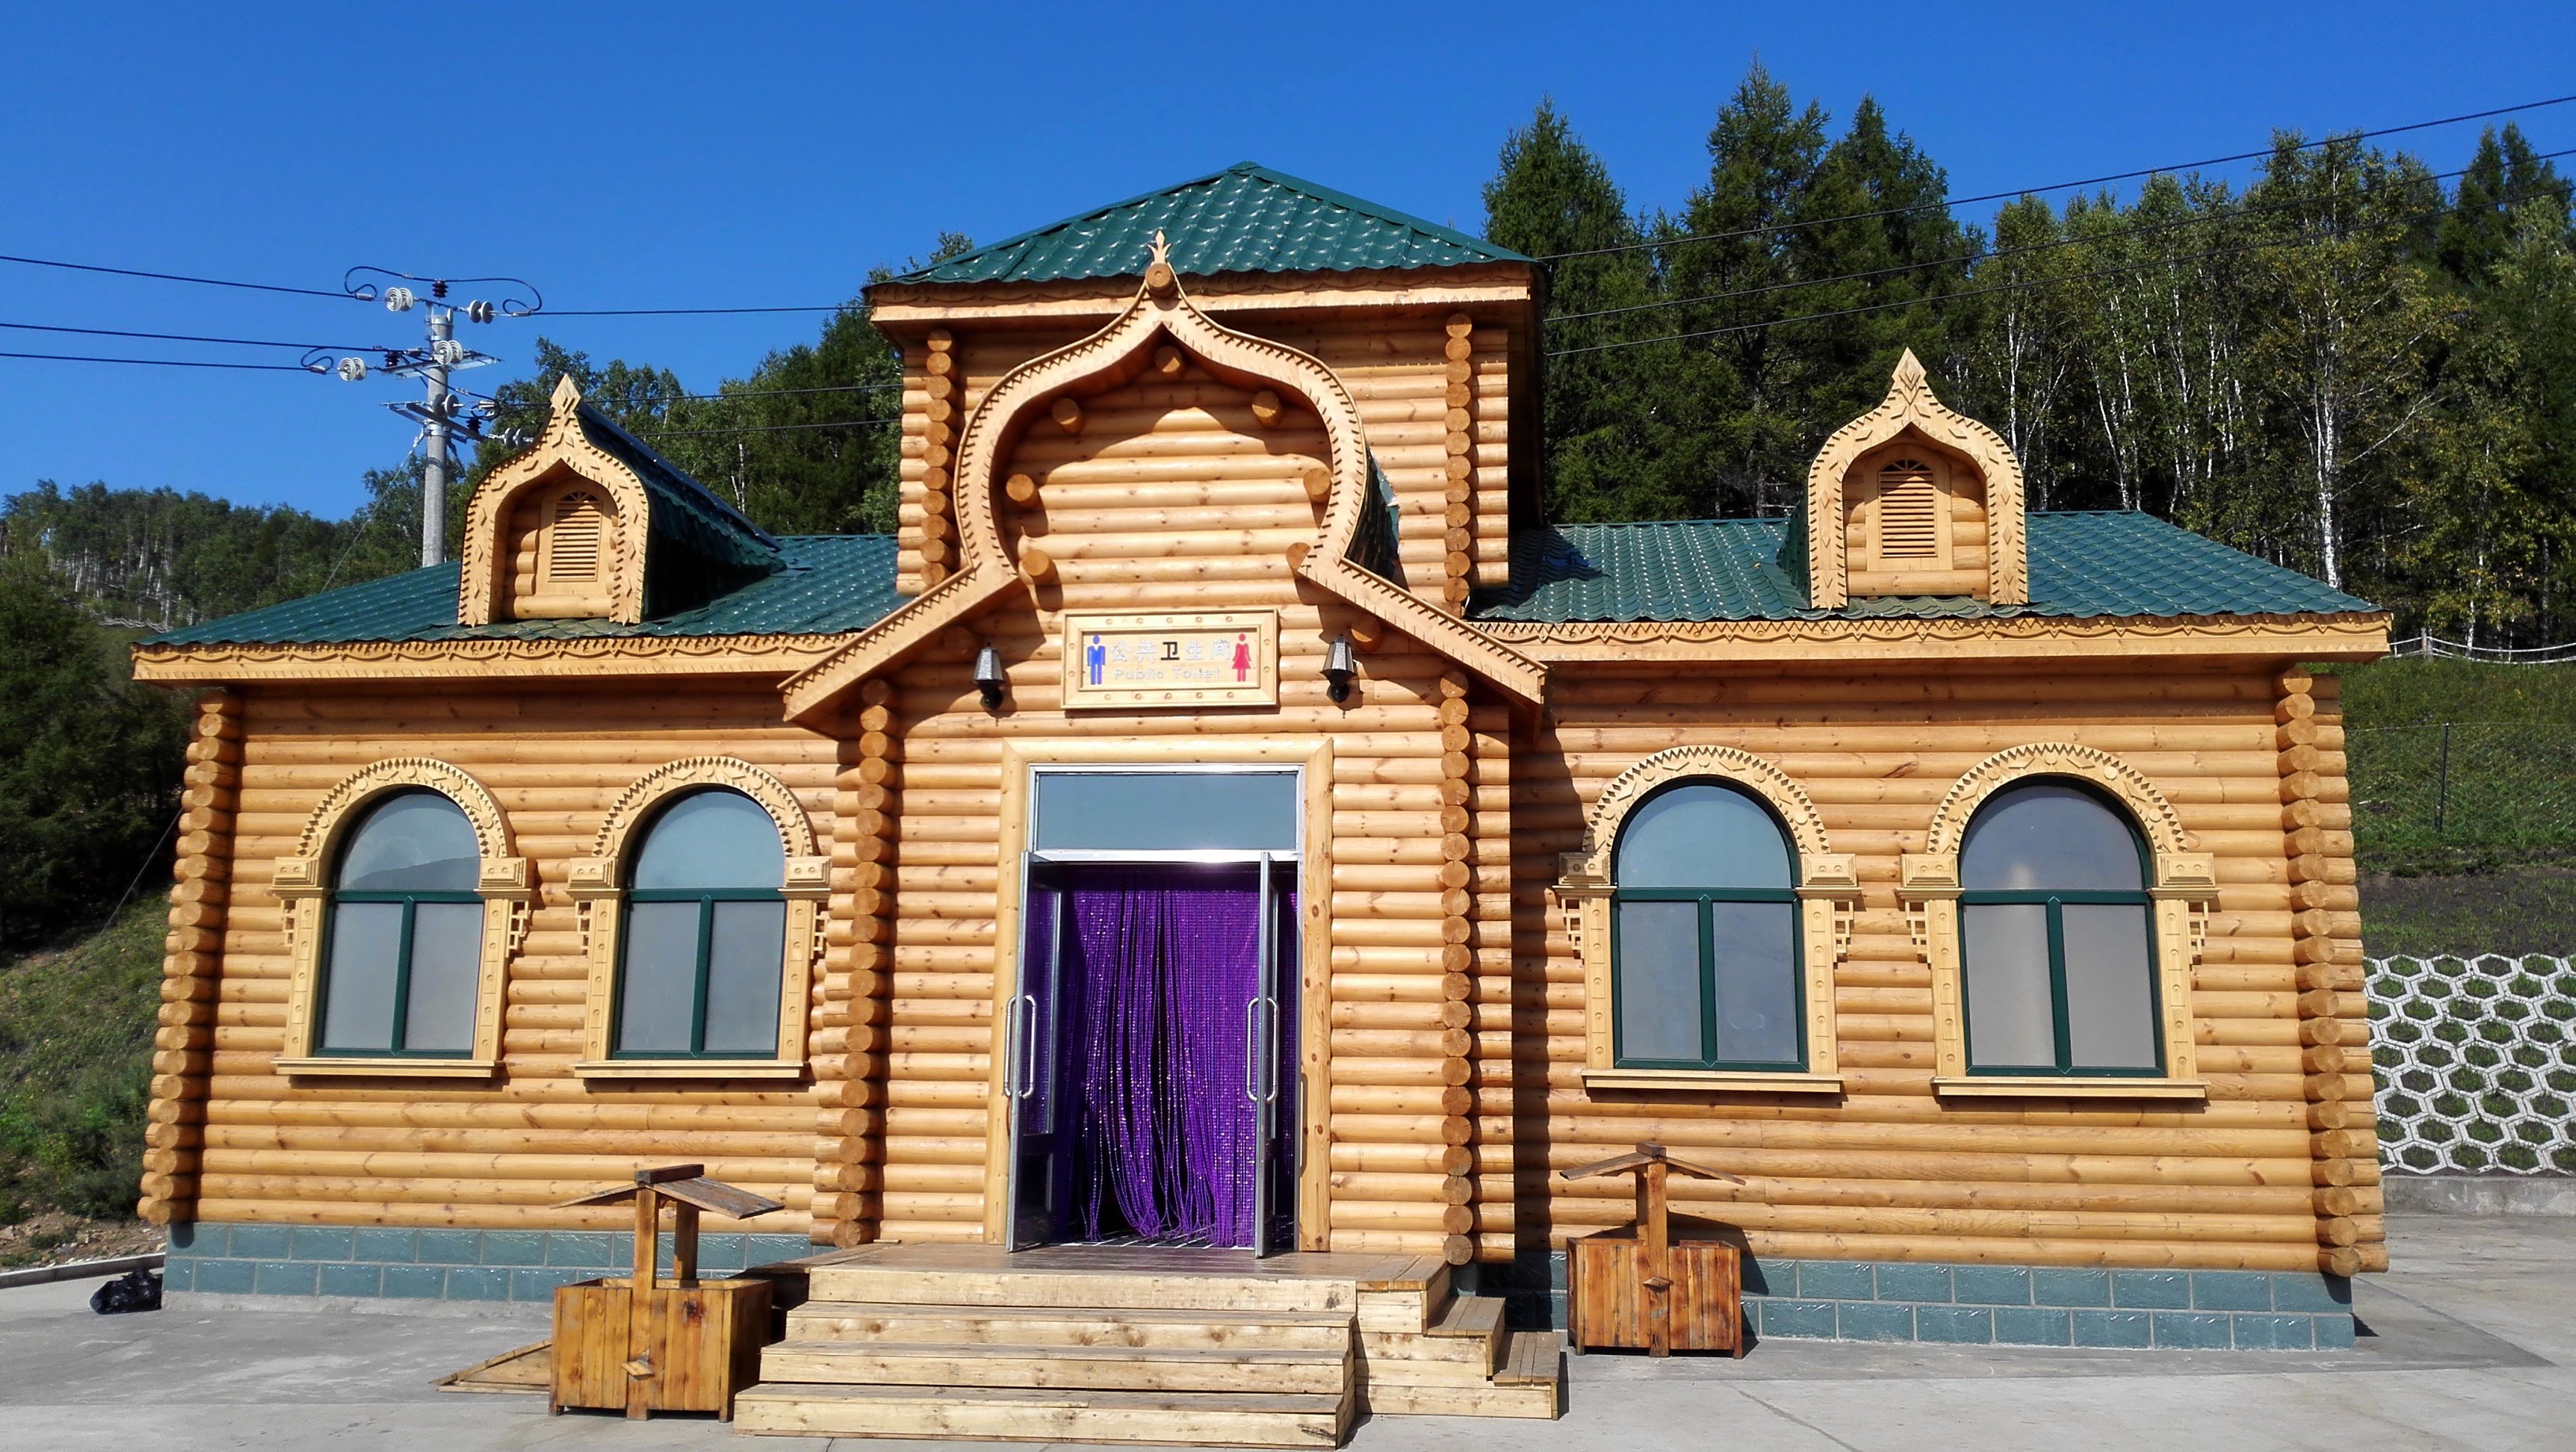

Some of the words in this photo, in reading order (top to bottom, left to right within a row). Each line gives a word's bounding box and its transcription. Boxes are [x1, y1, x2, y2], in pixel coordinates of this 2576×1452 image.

[1109, 639, 1231, 663] 公共卫生间
[1114, 668, 1165, 680] Public
